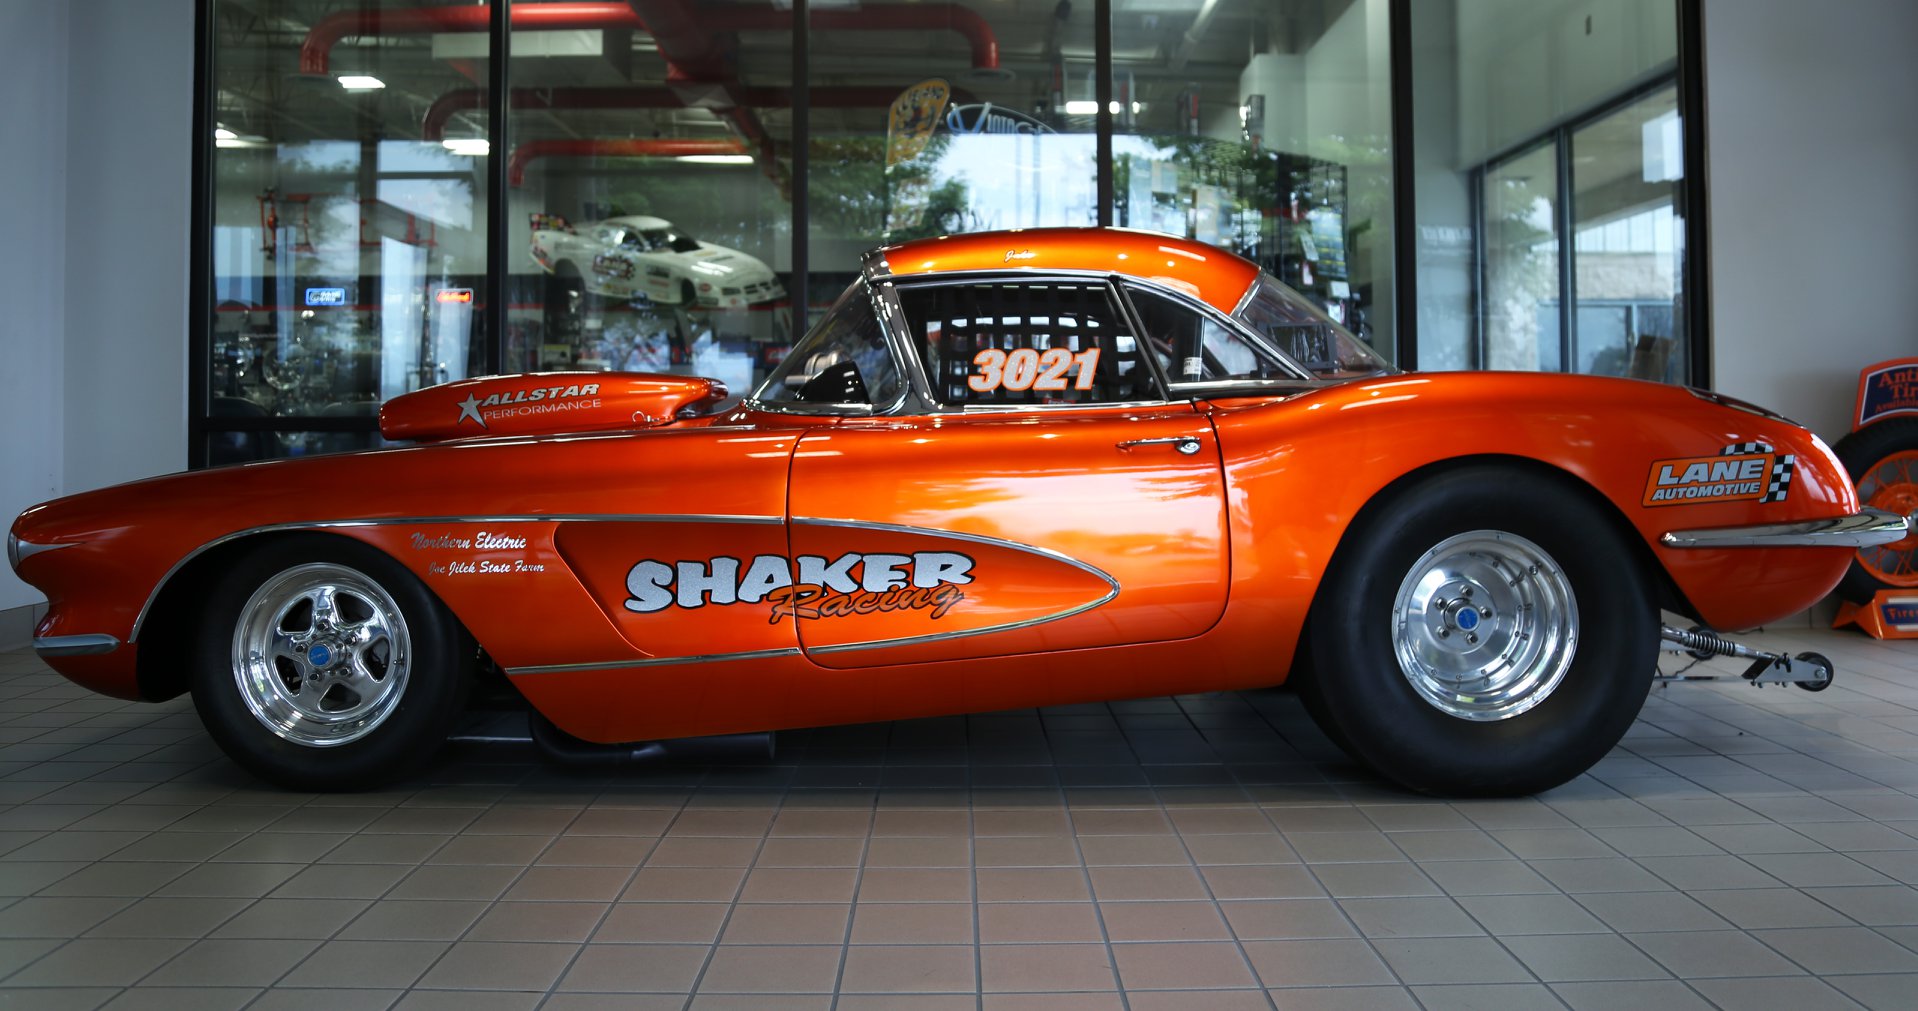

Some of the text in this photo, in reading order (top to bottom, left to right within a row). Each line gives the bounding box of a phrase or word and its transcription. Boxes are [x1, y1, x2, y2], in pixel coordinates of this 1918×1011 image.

[968, 348, 1101, 392] 3021
[482, 383, 600, 406] ALLSTAR
[483, 399, 602, 420] PERFORMANCE
[1657, 459, 1766, 486] LANE
[1651, 482, 1761, 501] AUTOMOTIVE
[411, 531, 527, 550] Northern Electric
[428, 561, 446, 576] Joe
[479, 560, 511, 573] State
[514, 560, 545, 573] Farm
[624, 552, 976, 613] SHAKER
[768, 583, 966, 624] Racing
